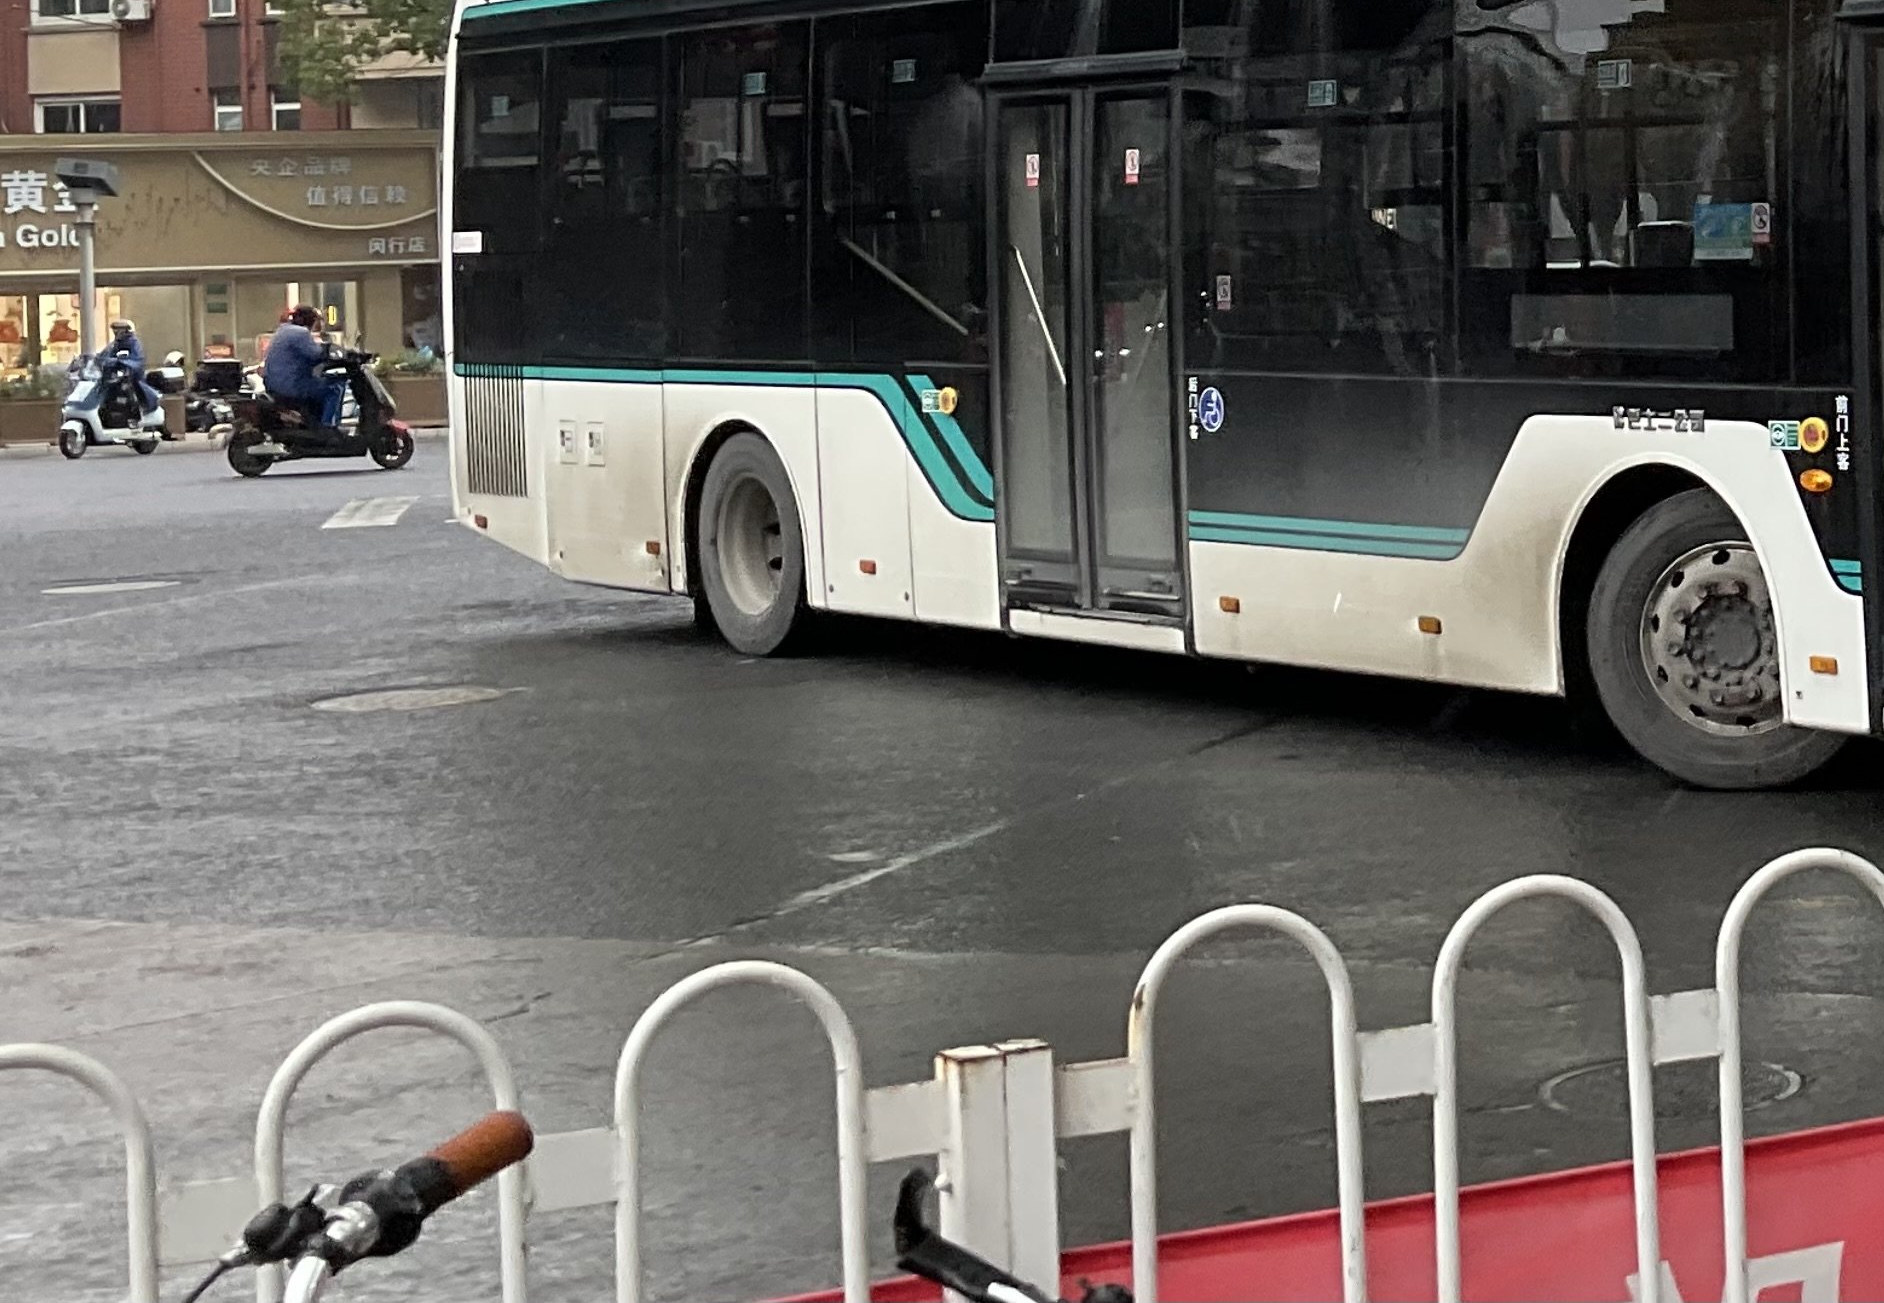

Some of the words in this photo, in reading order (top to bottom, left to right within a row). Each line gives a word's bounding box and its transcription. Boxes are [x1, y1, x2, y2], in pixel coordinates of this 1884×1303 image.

[251, 156, 352, 176] 央企品牌
[306, 185, 408, 206] 值得信赖
[368, 236, 426, 255] 闵行店
[1835, 395, 1850, 471] 前门上客
